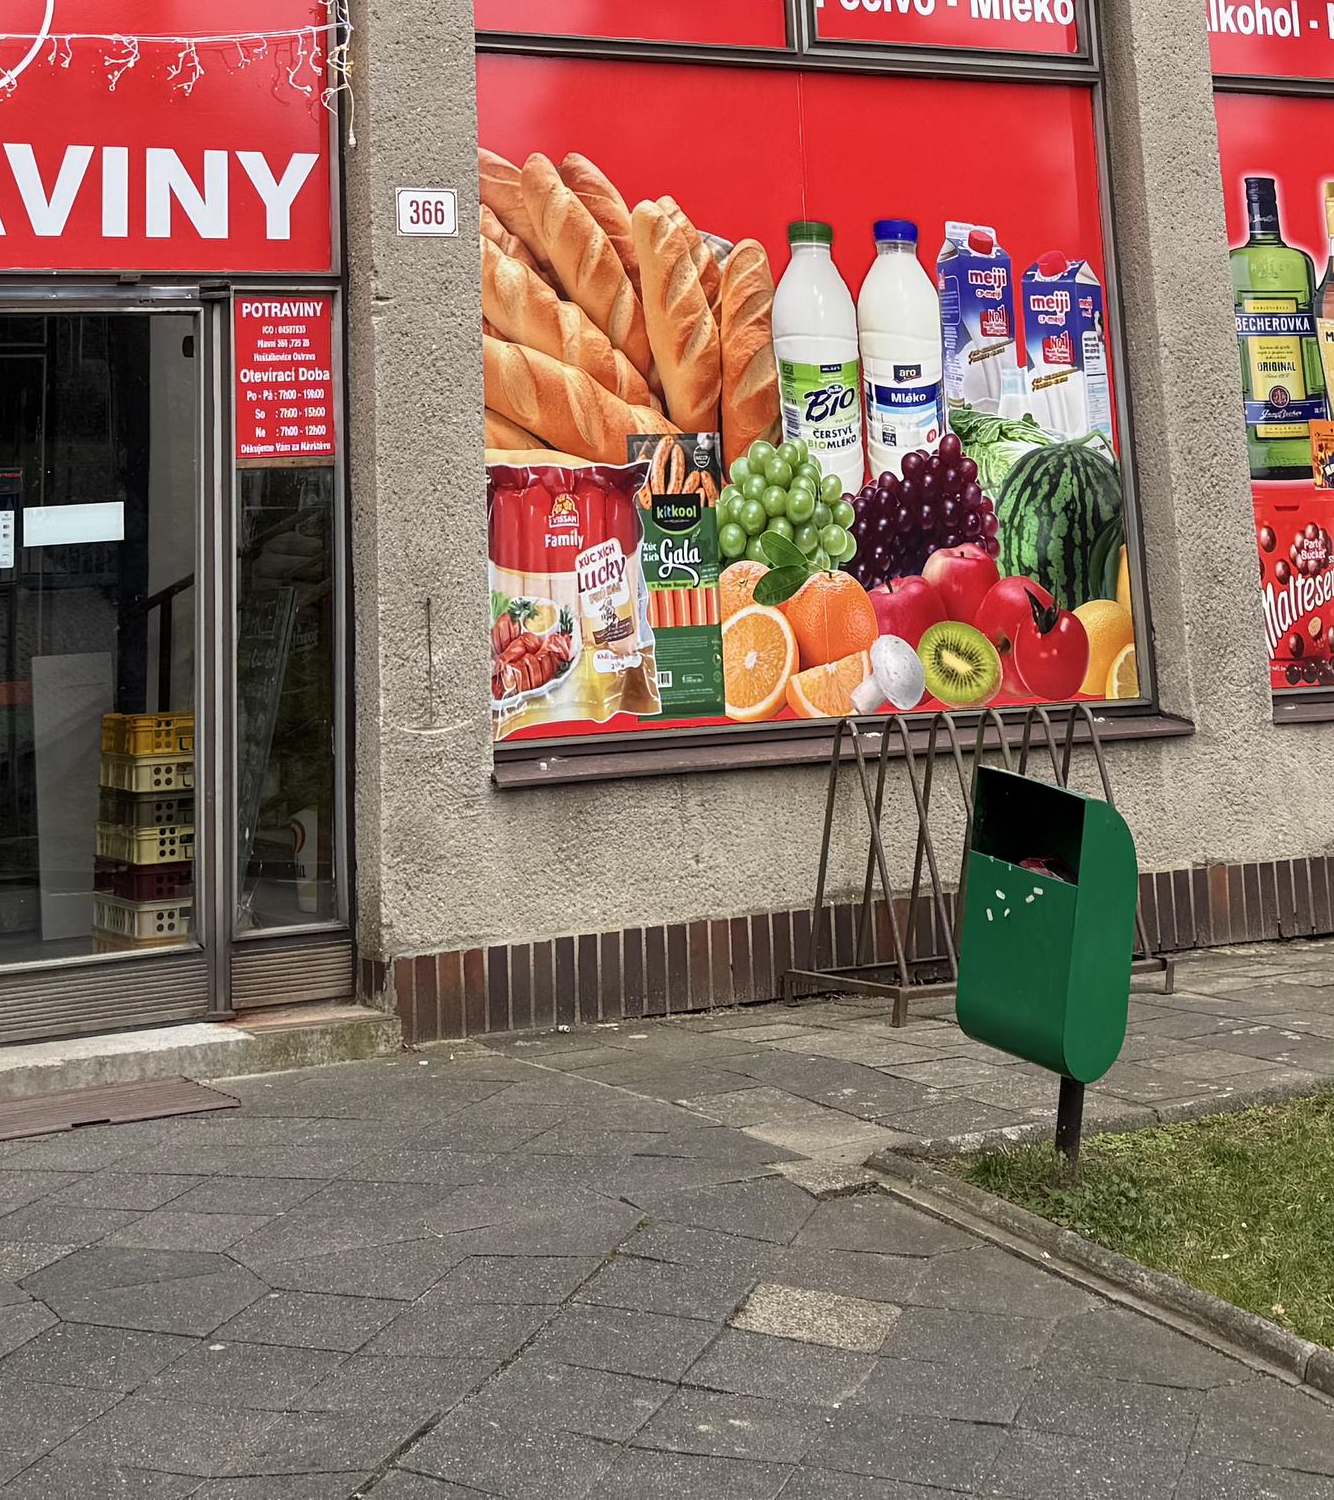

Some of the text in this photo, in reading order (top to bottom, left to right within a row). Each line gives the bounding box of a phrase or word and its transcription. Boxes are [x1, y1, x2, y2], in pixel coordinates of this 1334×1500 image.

[410, 200, 444, 225] 366
[969, 267, 1007, 288] meiji
[242, 302, 323, 318] POTRAVINY
[1030, 291, 1070, 314] meiji
[1236, 317, 1311, 331] BECHEROVKA
[899, 369, 917, 378] aro
[1257, 361, 1297, 372] ORIGINAL
[240, 367, 331, 383] Otevírací Doba
[247, 390, 257, 401] Po
[255, 409, 266, 419] So
[255, 427, 266, 437] Ne
[813, 423, 853, 439] ČERSTVÉ
[657, 505, 697, 519] kitkool
[545, 529, 584, 550] Family
[1303, 539, 1321, 552] Party
[658, 538, 702, 588] Gala
[577, 556, 626, 594] Lucky
